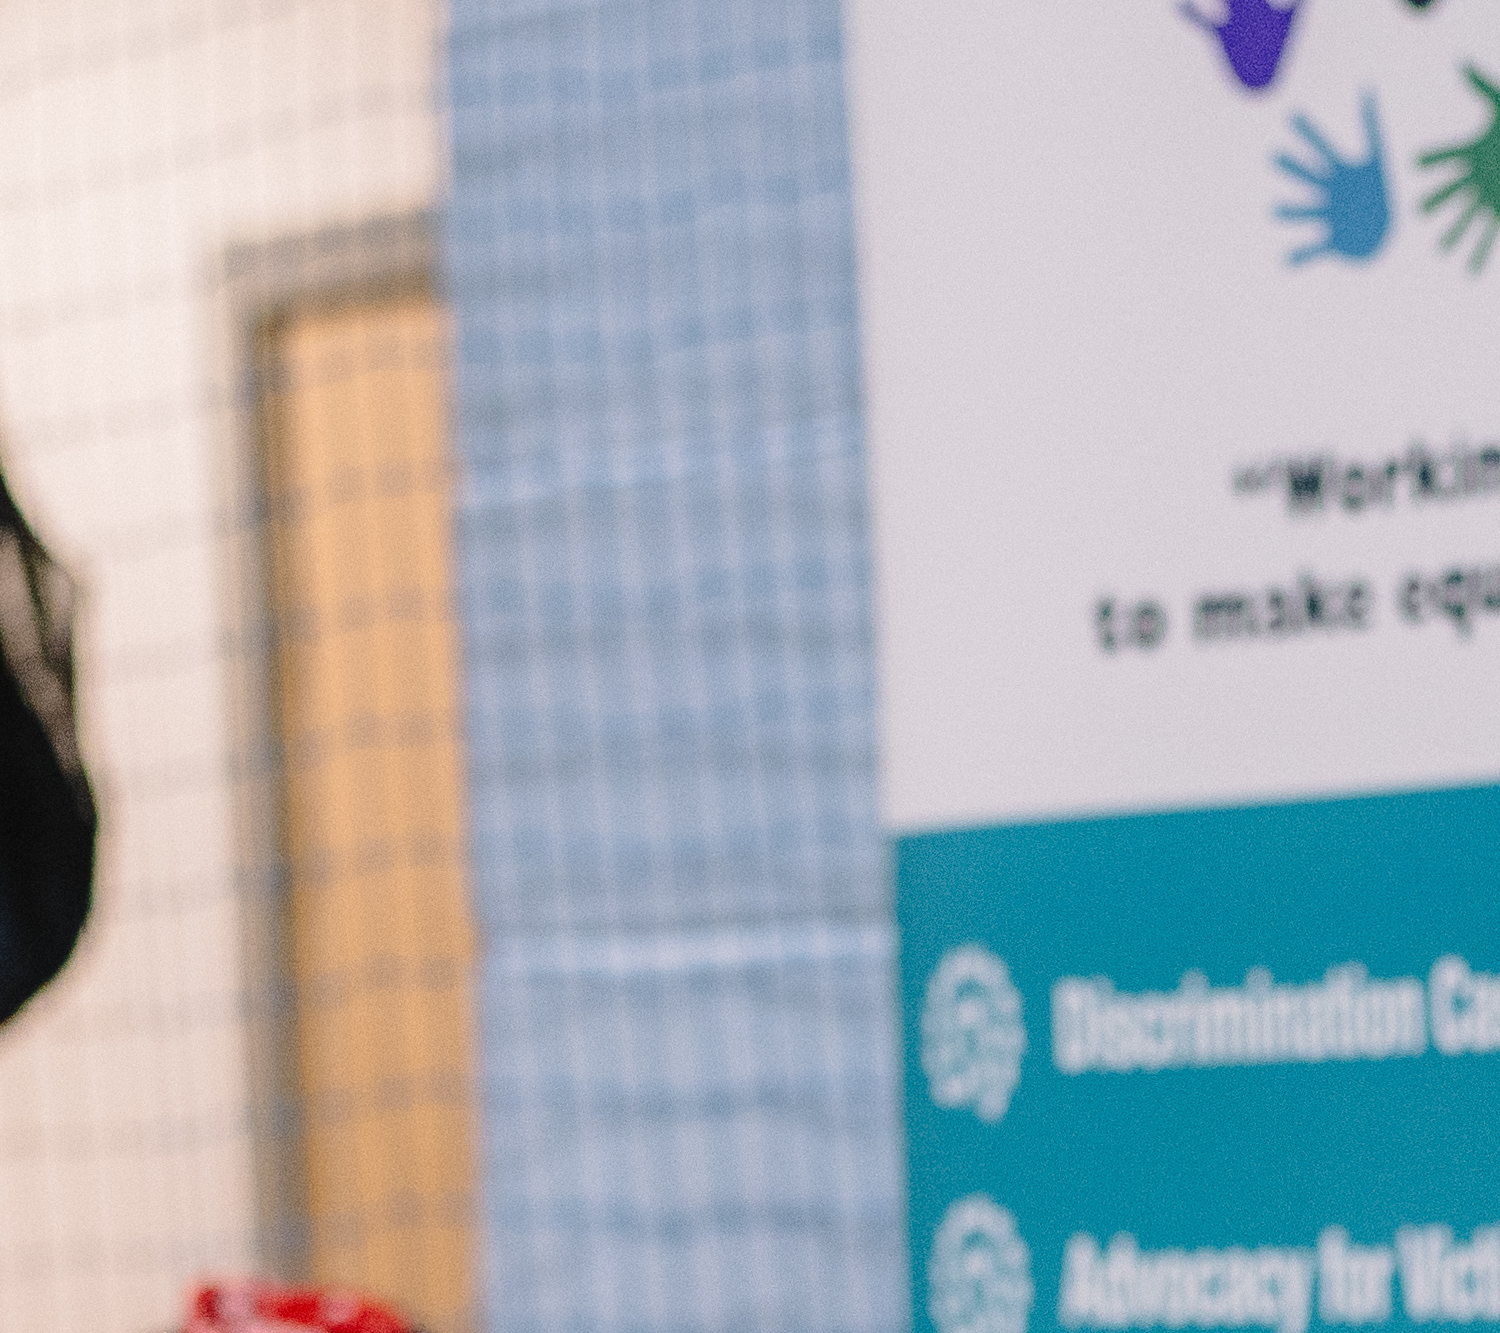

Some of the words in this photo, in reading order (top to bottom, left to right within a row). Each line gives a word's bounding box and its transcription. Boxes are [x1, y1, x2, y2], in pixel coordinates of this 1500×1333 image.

[1094, 593, 1171, 657] to
[1192, 567, 1377, 648] make
[1051, 964, 1428, 1075] Discrimination
[1316, 1223, 1393, 1324] for
